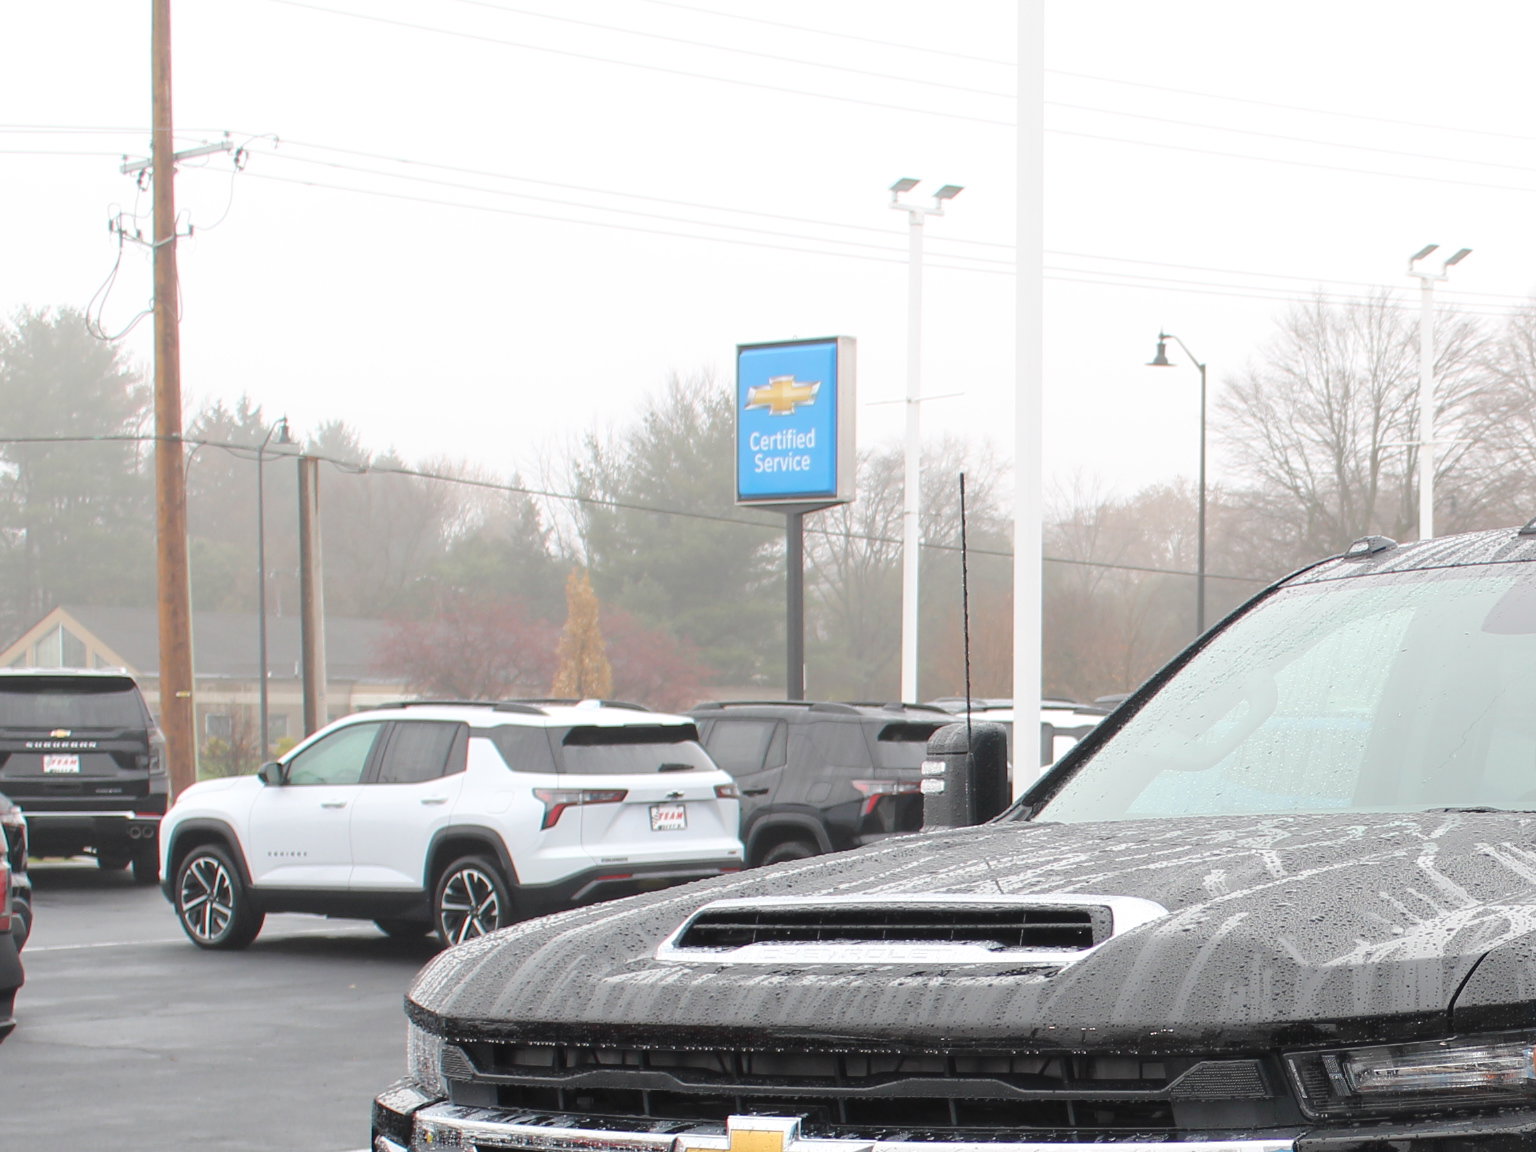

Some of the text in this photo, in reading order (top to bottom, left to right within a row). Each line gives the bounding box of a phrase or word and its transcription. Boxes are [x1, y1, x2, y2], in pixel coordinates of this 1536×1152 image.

[749, 428, 816, 451] Certified
[754, 452, 811, 473] Service
[658, 812, 683, 820] TEAM
